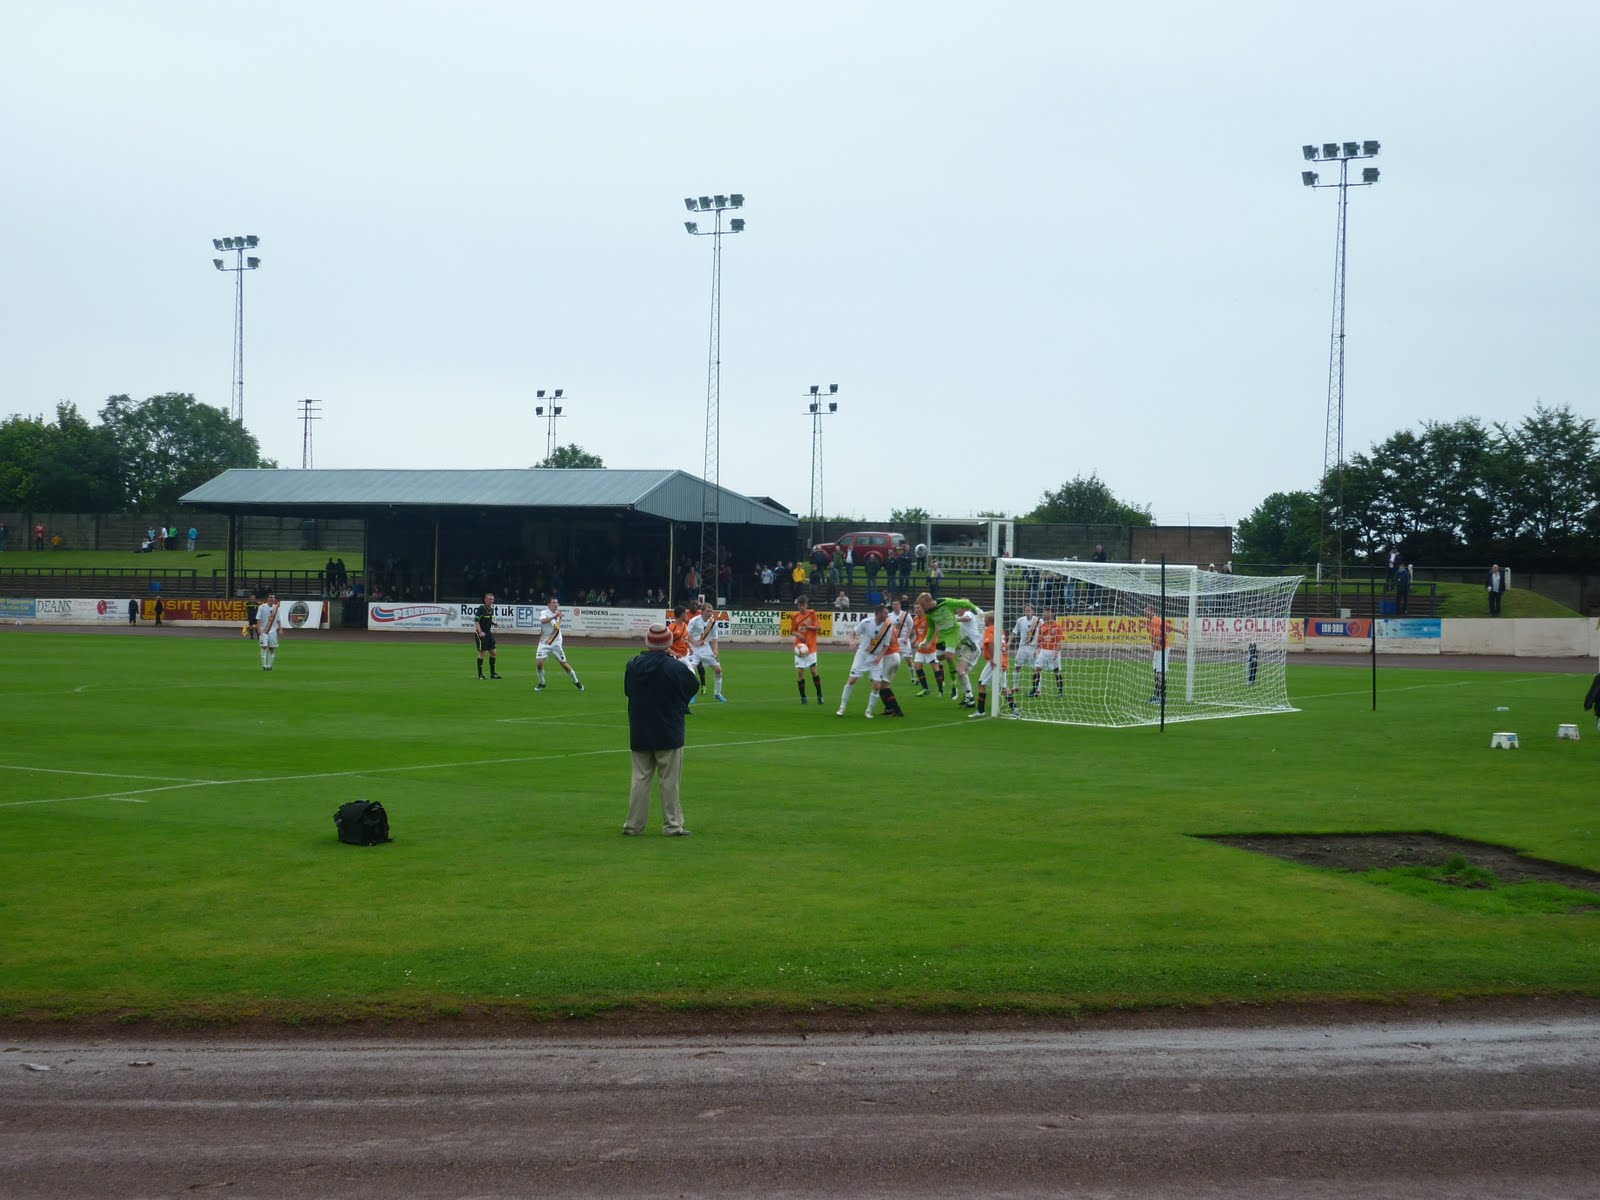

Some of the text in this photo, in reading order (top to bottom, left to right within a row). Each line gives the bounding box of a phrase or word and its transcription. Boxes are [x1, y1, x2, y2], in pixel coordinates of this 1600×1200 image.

[37, 600, 72, 613] DEANS
[167, 601, 200, 611] SITE
[502, 606, 514, 617] uk
[518, 608, 532, 621] EP
[1061, 619, 1103, 633] IDEAL
